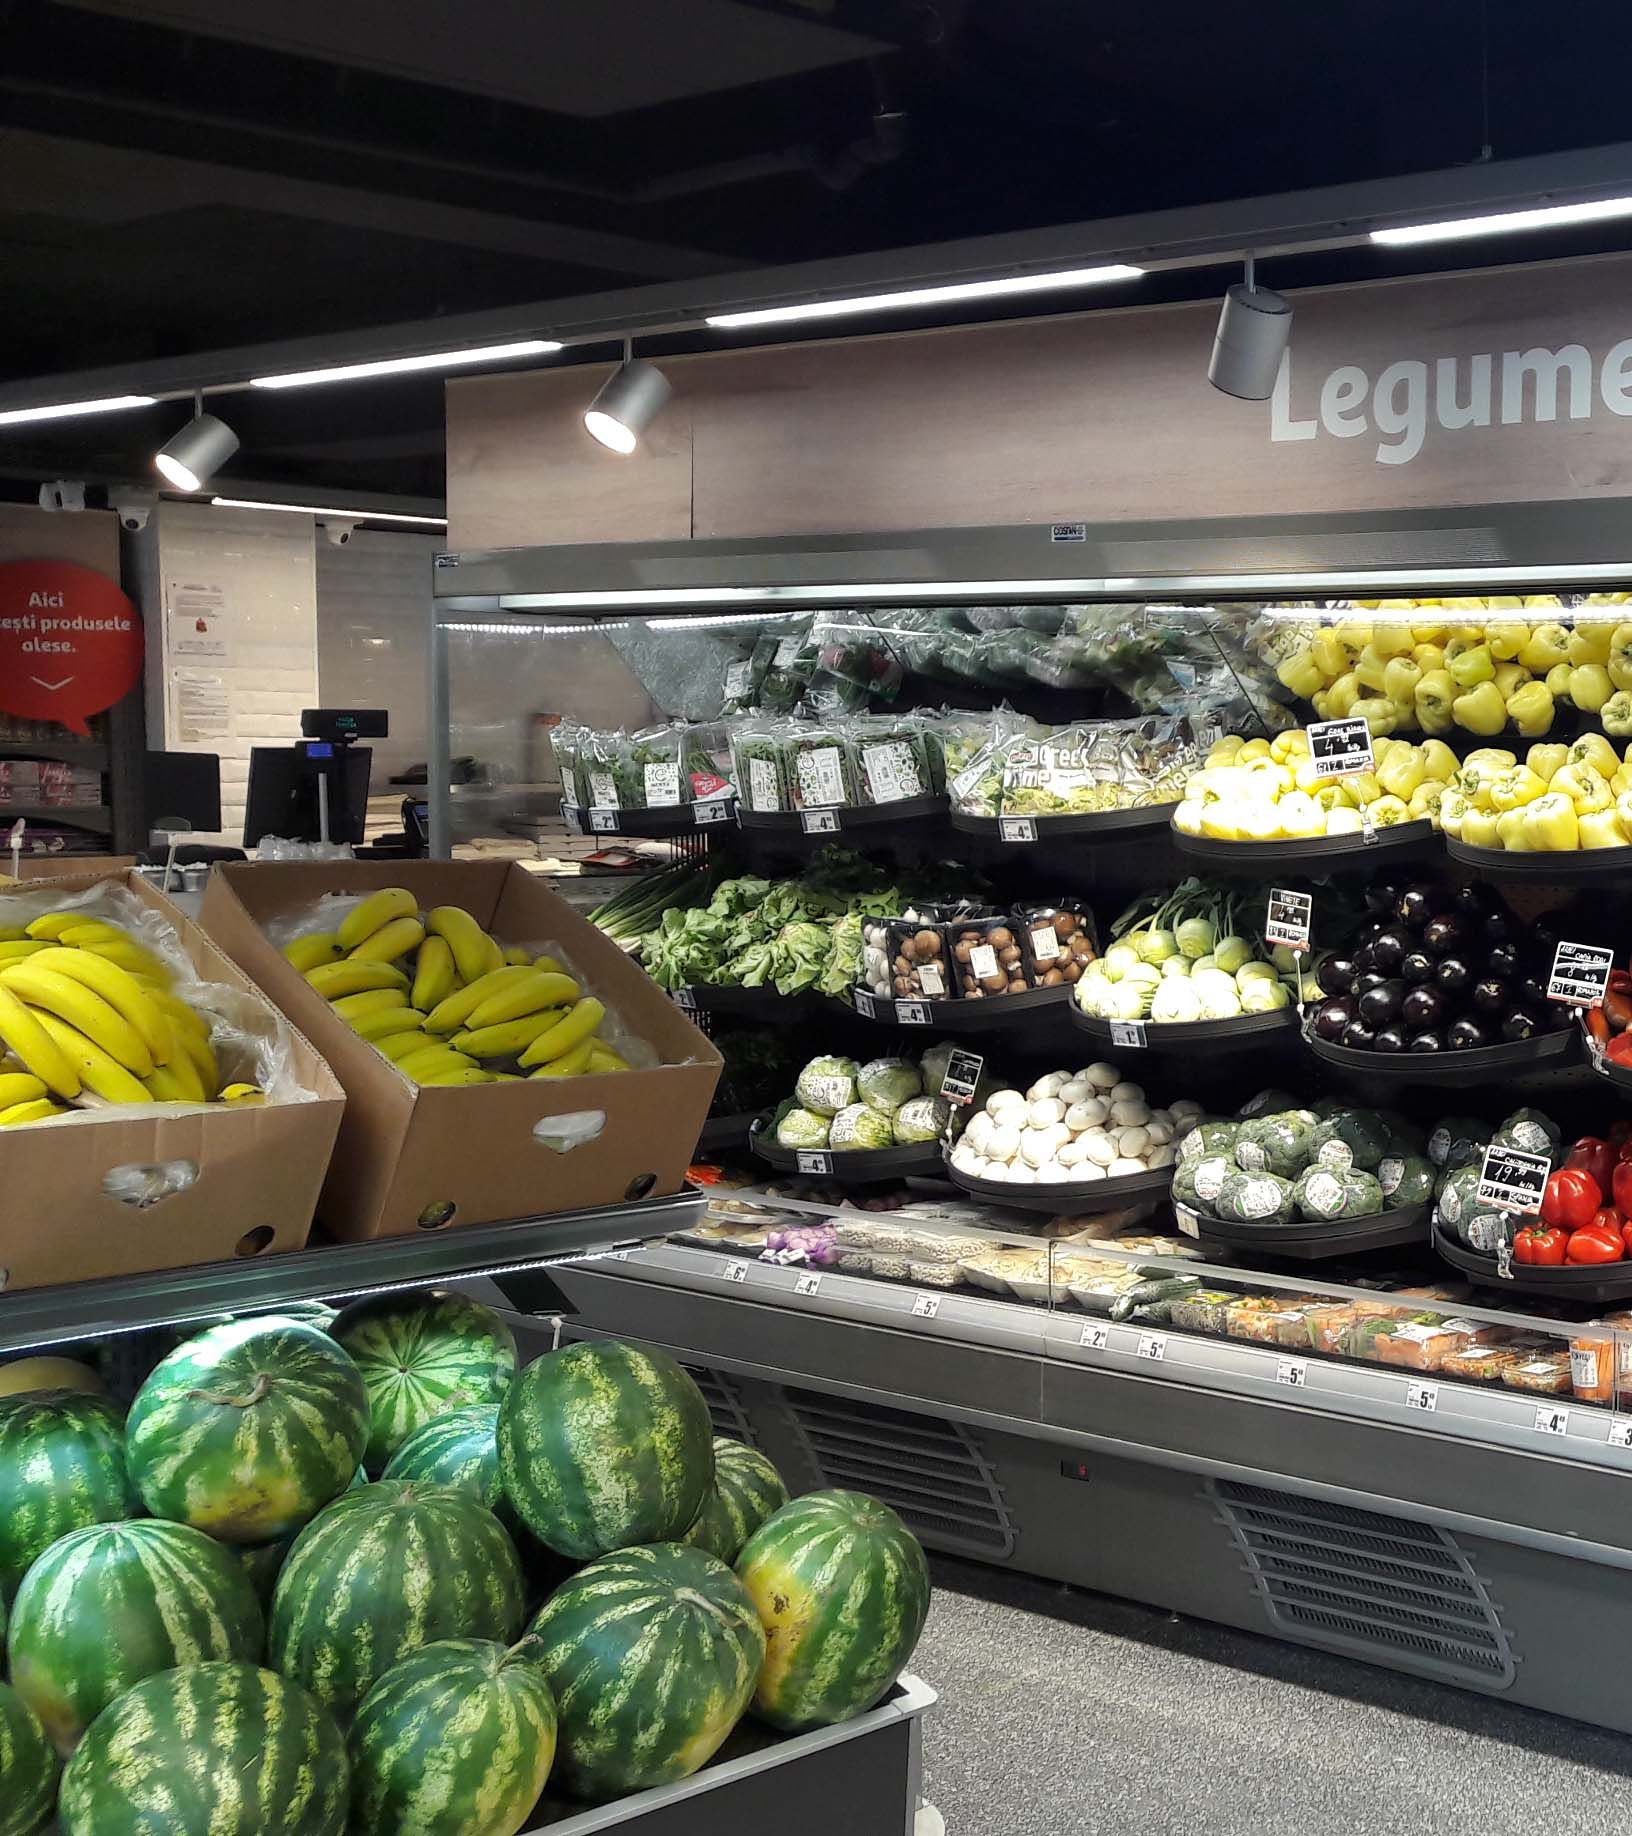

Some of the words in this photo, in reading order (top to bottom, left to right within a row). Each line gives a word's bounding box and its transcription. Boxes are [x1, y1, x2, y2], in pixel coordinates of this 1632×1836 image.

[29, 592, 64, 608] Aici
[0, 614, 36, 634] ești
[40, 615, 131, 634] produsele
[22, 636, 76, 653] alese.
[1550, 1414, 1559, 1431] 4
